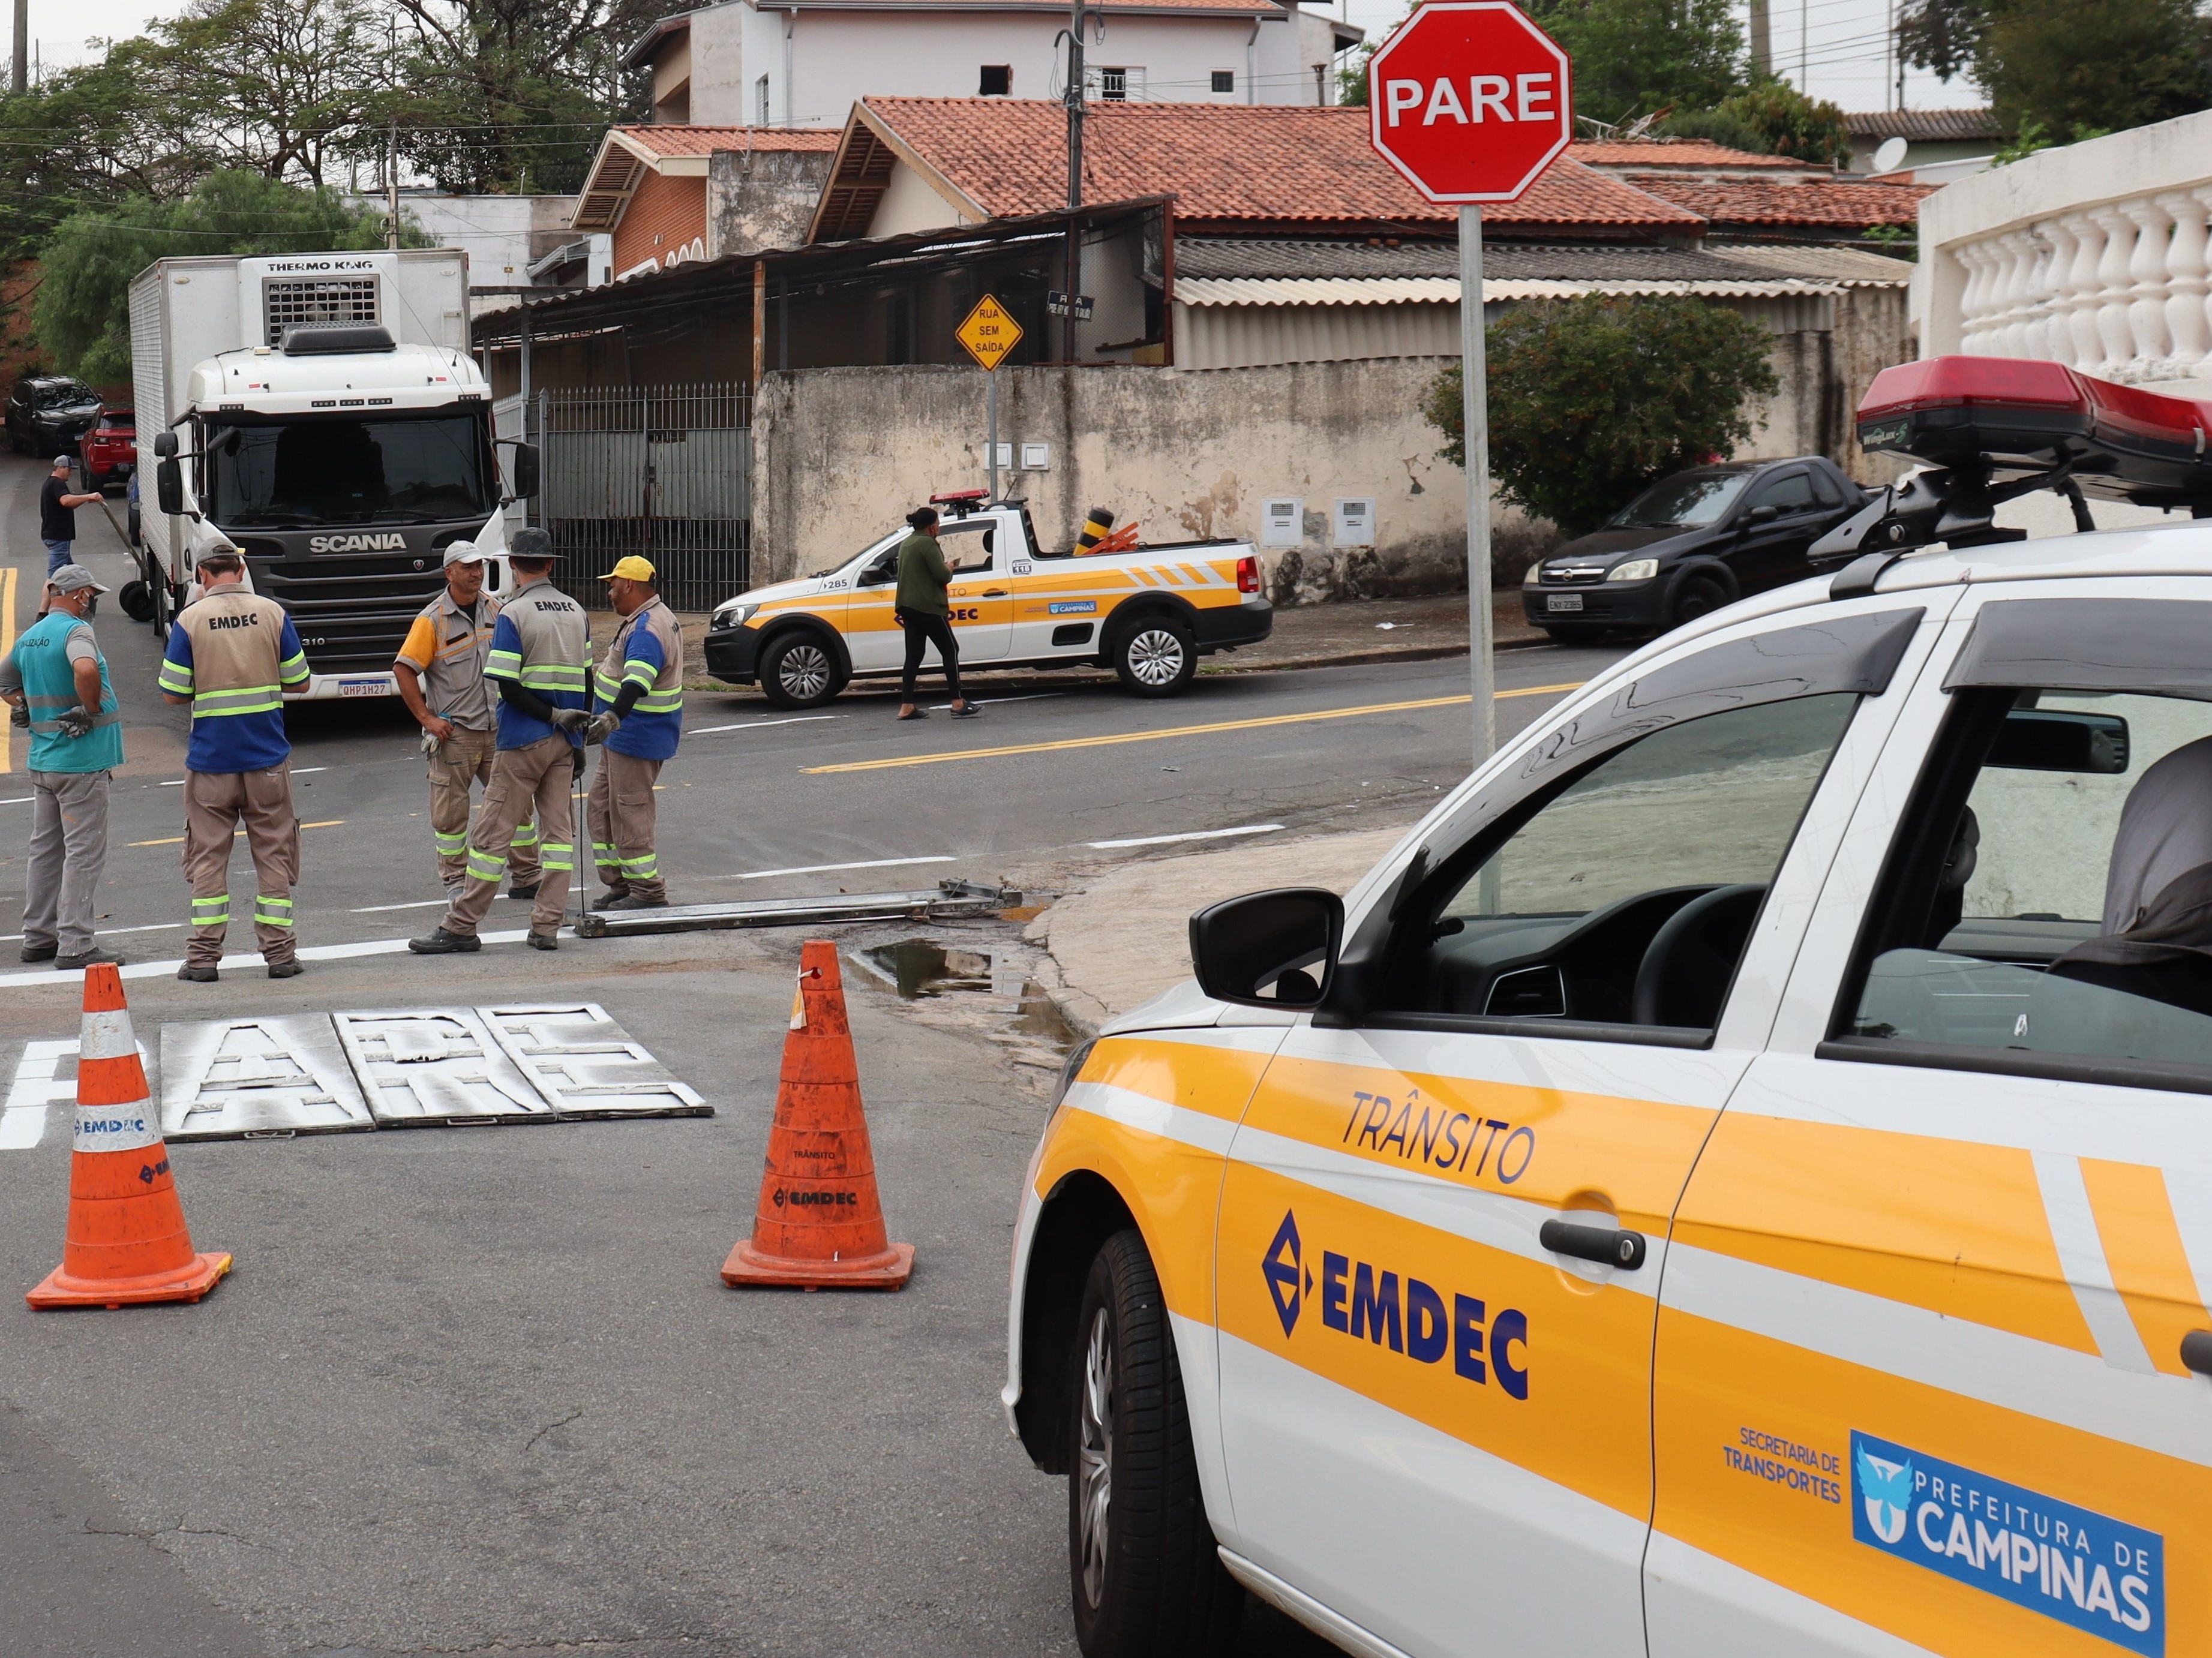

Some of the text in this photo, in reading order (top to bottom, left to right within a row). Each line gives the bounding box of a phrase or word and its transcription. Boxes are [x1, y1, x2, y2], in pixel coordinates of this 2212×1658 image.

[1386, 72, 1555, 127] PARE
[268, 261, 373, 272] THERMO KING
[1060, 295, 1083, 305] RA
[979, 309, 999, 319] RUA
[979, 326, 999, 335] SEM
[975, 340, 1004, 353] SAÍDA
[310, 533, 407, 553] SCANIA
[829, 579, 847, 589] 285
[535, 601, 575, 612] EMDEC
[947, 608, 979, 621] DEC
[209, 613, 258, 630] EMDEC
[343, 684, 385, 695] QHP1H27
[1343, 1089, 1535, 1184] TRÂNSITO
[794, 1149, 835, 1160] TRÂNSITO
[790, 1191, 857, 1205] EMDEC
[1323, 1250, 1528, 1401] EMDEC
[1740, 1427, 1840, 1476] SECRETARIA DE
[1724, 1446, 1841, 1504] TRANSPORTES
[1916, 1470, 2150, 1576] PREFEITURA DE
[1917, 1501, 2151, 1632] CAMPINAS
